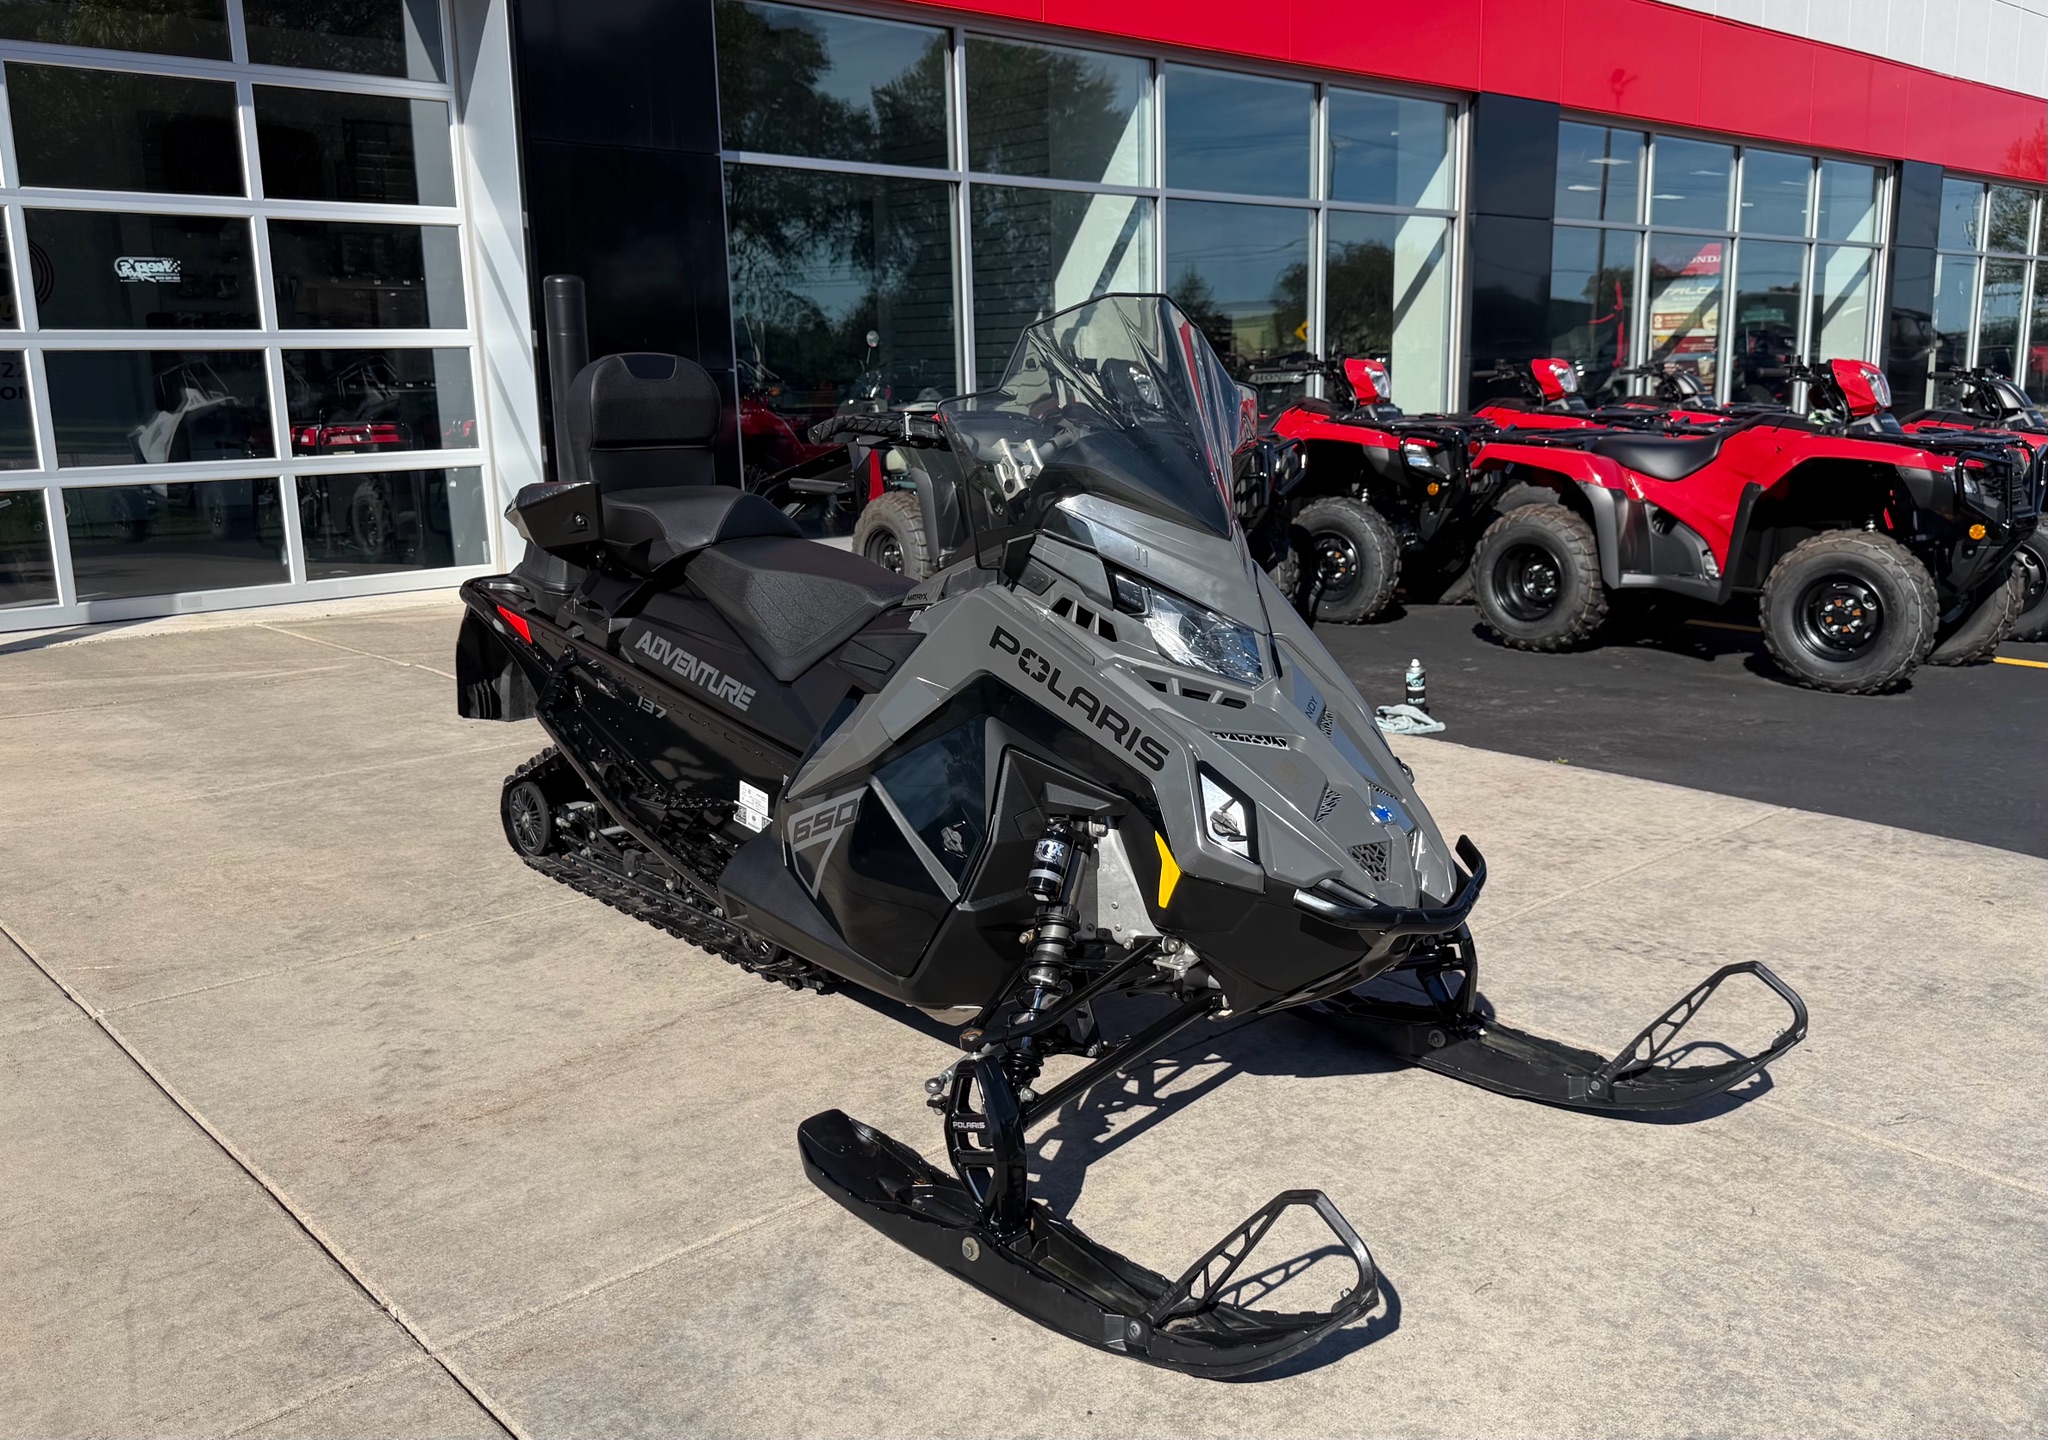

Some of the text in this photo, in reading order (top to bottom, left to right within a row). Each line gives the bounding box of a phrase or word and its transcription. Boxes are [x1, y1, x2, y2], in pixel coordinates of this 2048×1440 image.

[634, 630, 757, 712] ADVENTURE
[637, 695, 667, 719] 137
[989, 625, 1170, 772] POLARIS
[793, 797, 858, 846] 650
[1035, 840, 1065, 859] FOX
[952, 1121, 986, 1129] POLARIS
